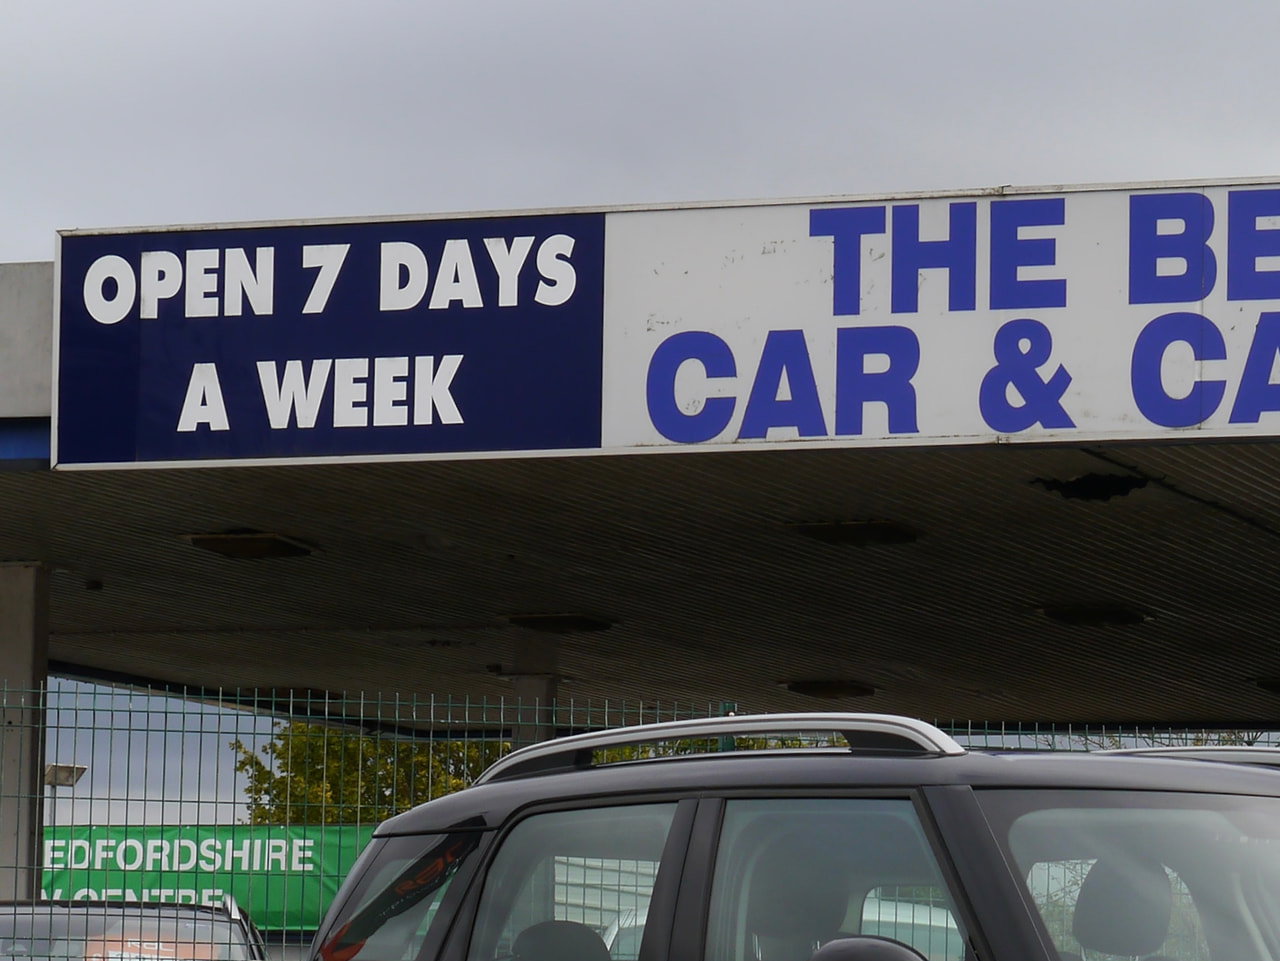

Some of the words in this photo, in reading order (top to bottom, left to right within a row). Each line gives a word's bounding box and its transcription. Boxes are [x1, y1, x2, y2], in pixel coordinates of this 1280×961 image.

[83, 246, 275, 325] OPEN
[302, 243, 351, 314] 7
[379, 233, 578, 311] DAYS
[809, 197, 1067, 316] THE
[176, 362, 230, 432] A
[256, 354, 465, 430] WEEK
[646, 325, 920, 444] CAR
[979, 318, 1077, 433] &
